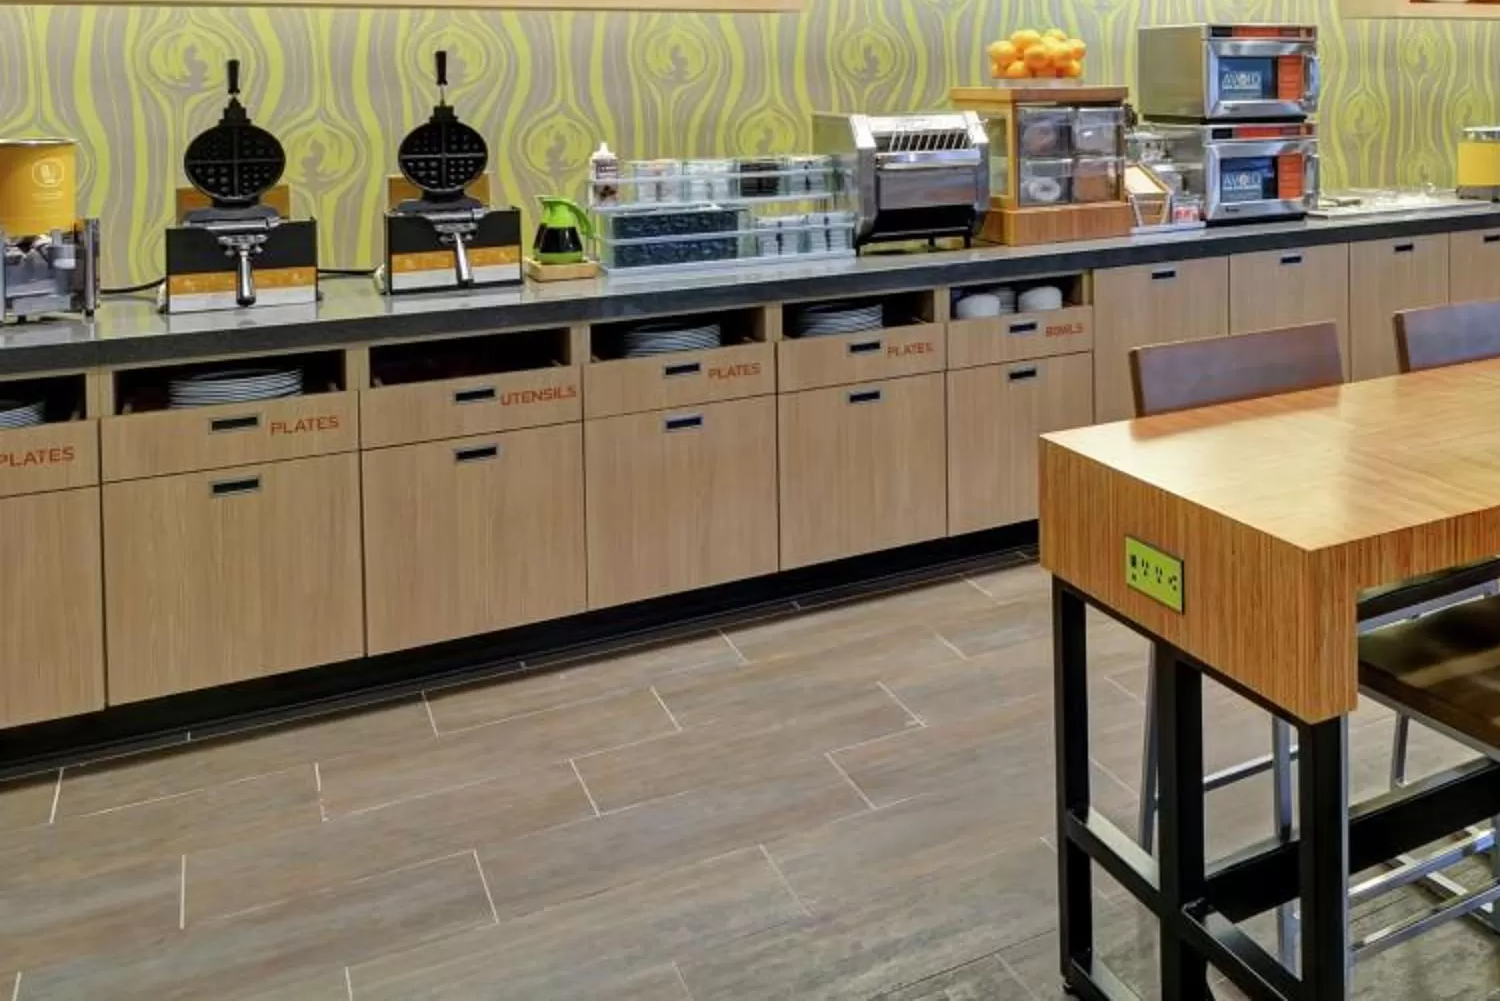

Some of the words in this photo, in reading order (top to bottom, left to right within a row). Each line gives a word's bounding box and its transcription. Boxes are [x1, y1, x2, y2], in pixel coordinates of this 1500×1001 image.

[708, 362, 761, 380] PLATES
[501, 385, 577, 406] UTENSILS
[269, 415, 340, 436] PLATES
